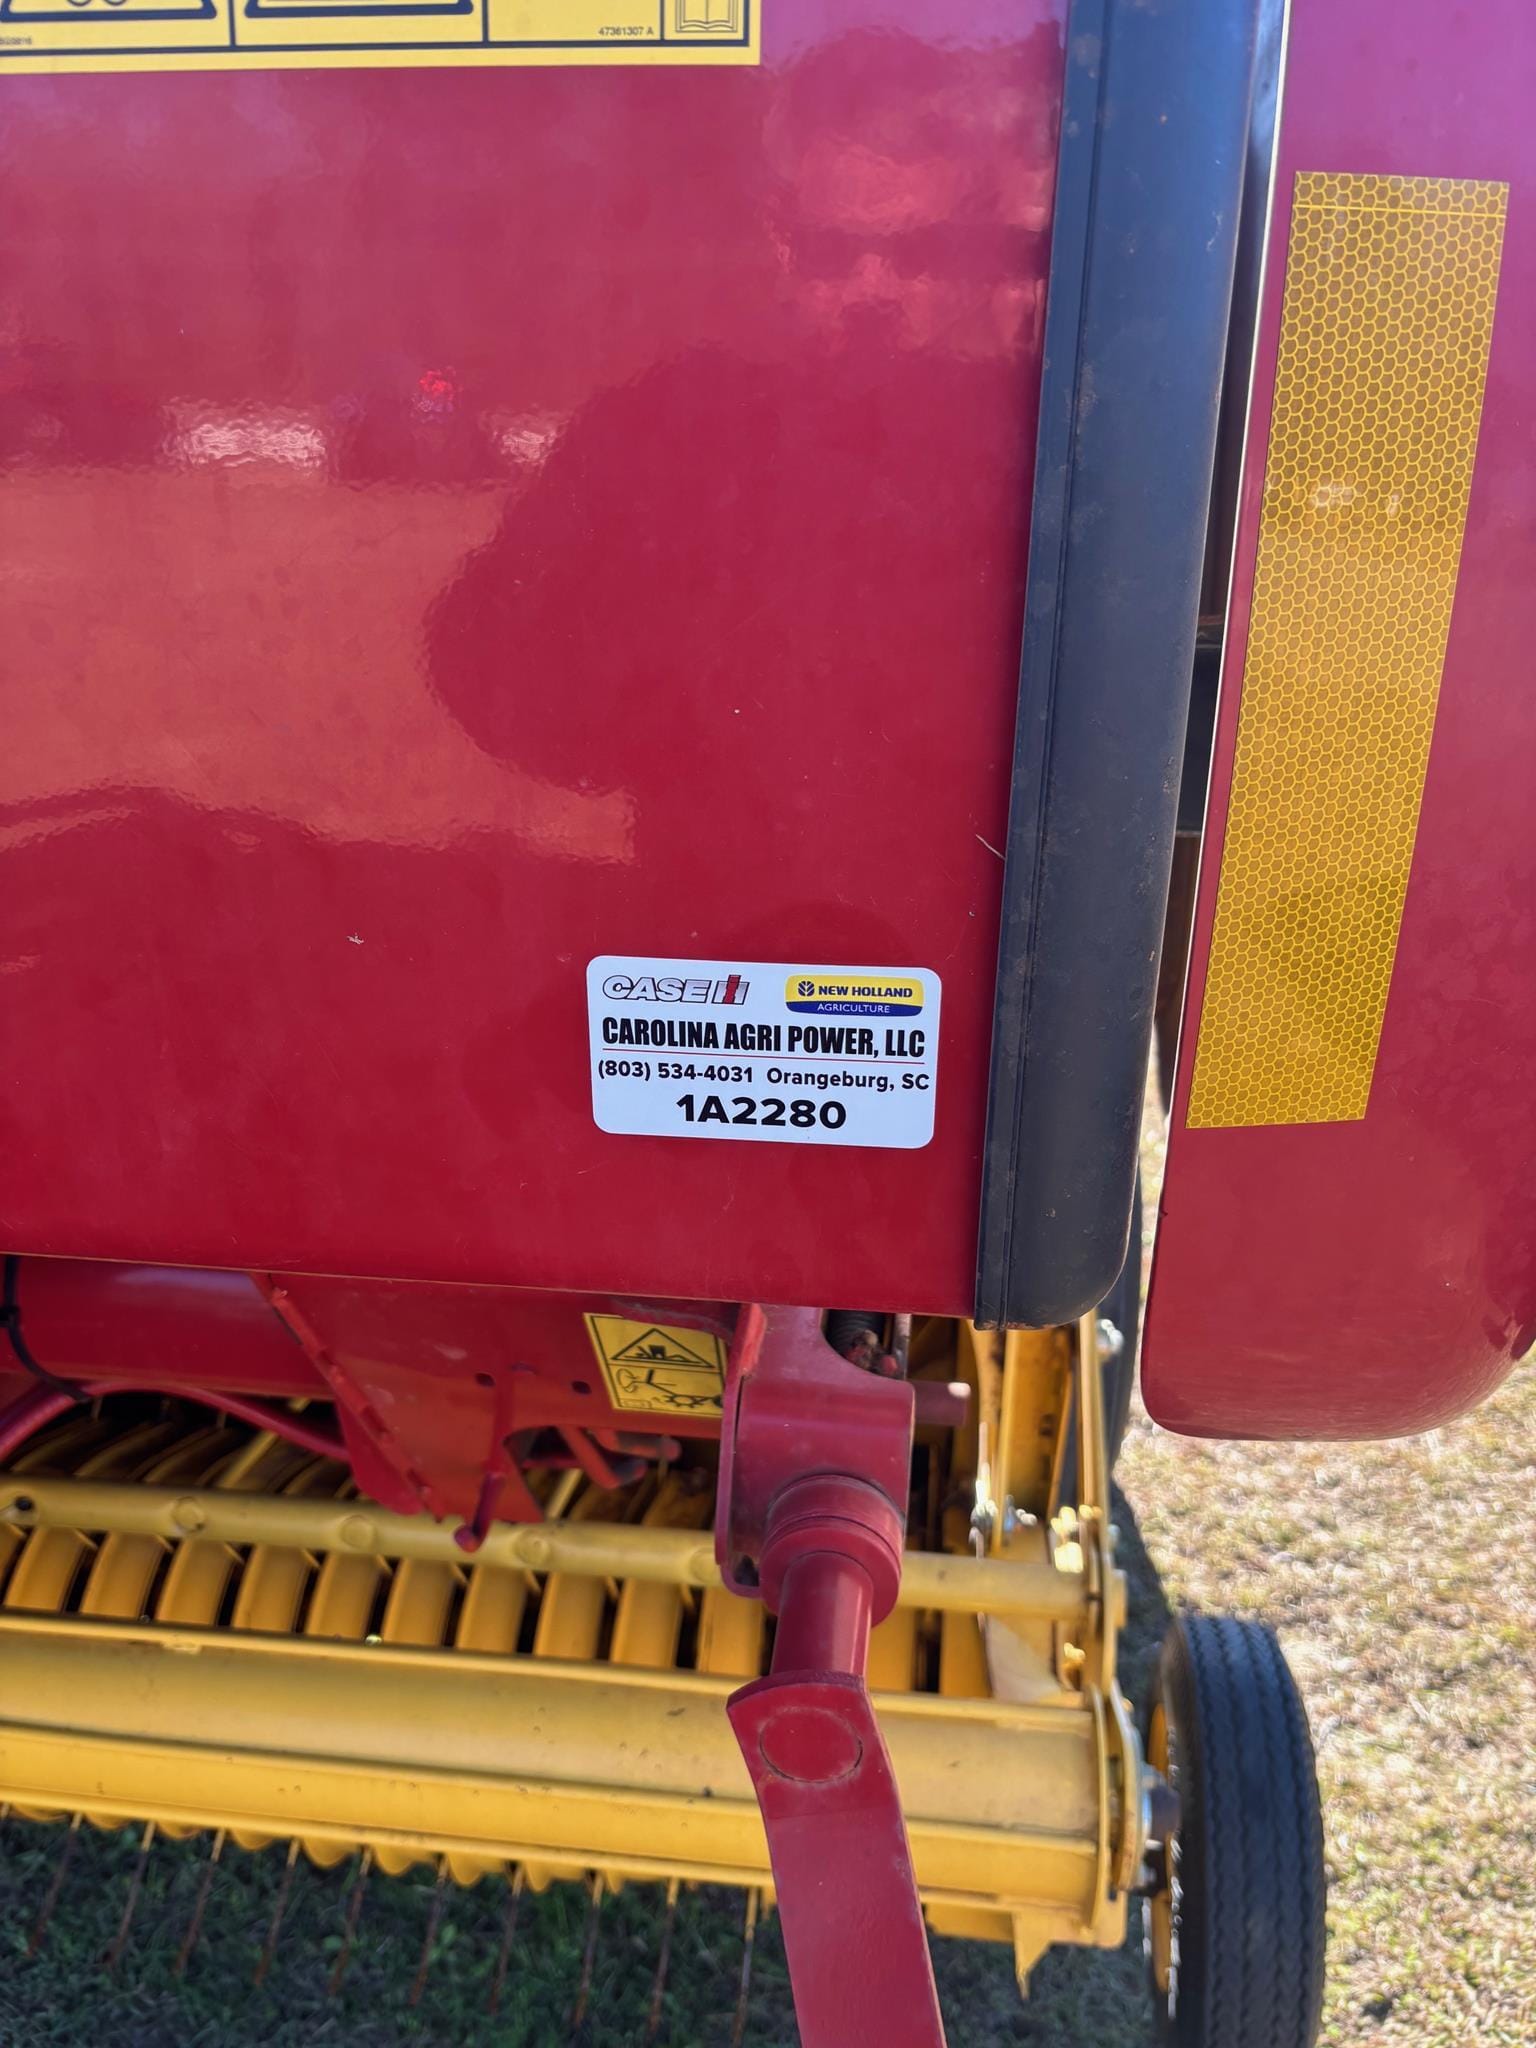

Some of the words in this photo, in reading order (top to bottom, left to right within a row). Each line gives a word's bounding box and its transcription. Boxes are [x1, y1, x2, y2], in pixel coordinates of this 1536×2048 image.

[602, 975, 712, 1004] CASE
[818, 985, 849, 996] NEW
[851, 986, 913, 998] HOLLAND
[817, 1003, 891, 1014] AGRICULTURE
[602, 1017, 720, 1049] CAROLINA
[724, 1023, 781, 1052] AGRI
[788, 1026, 879, 1058] POWER,
[885, 1029, 925, 1057] LLC
[598, 1059, 651, 1082] (803)
[658, 1062, 753, 1083] 534-4031
[766, 1067, 894, 1092] Orangeburg,
[901, 1073, 930, 1090] SC
[676, 1094, 847, 1129] 1A2280
